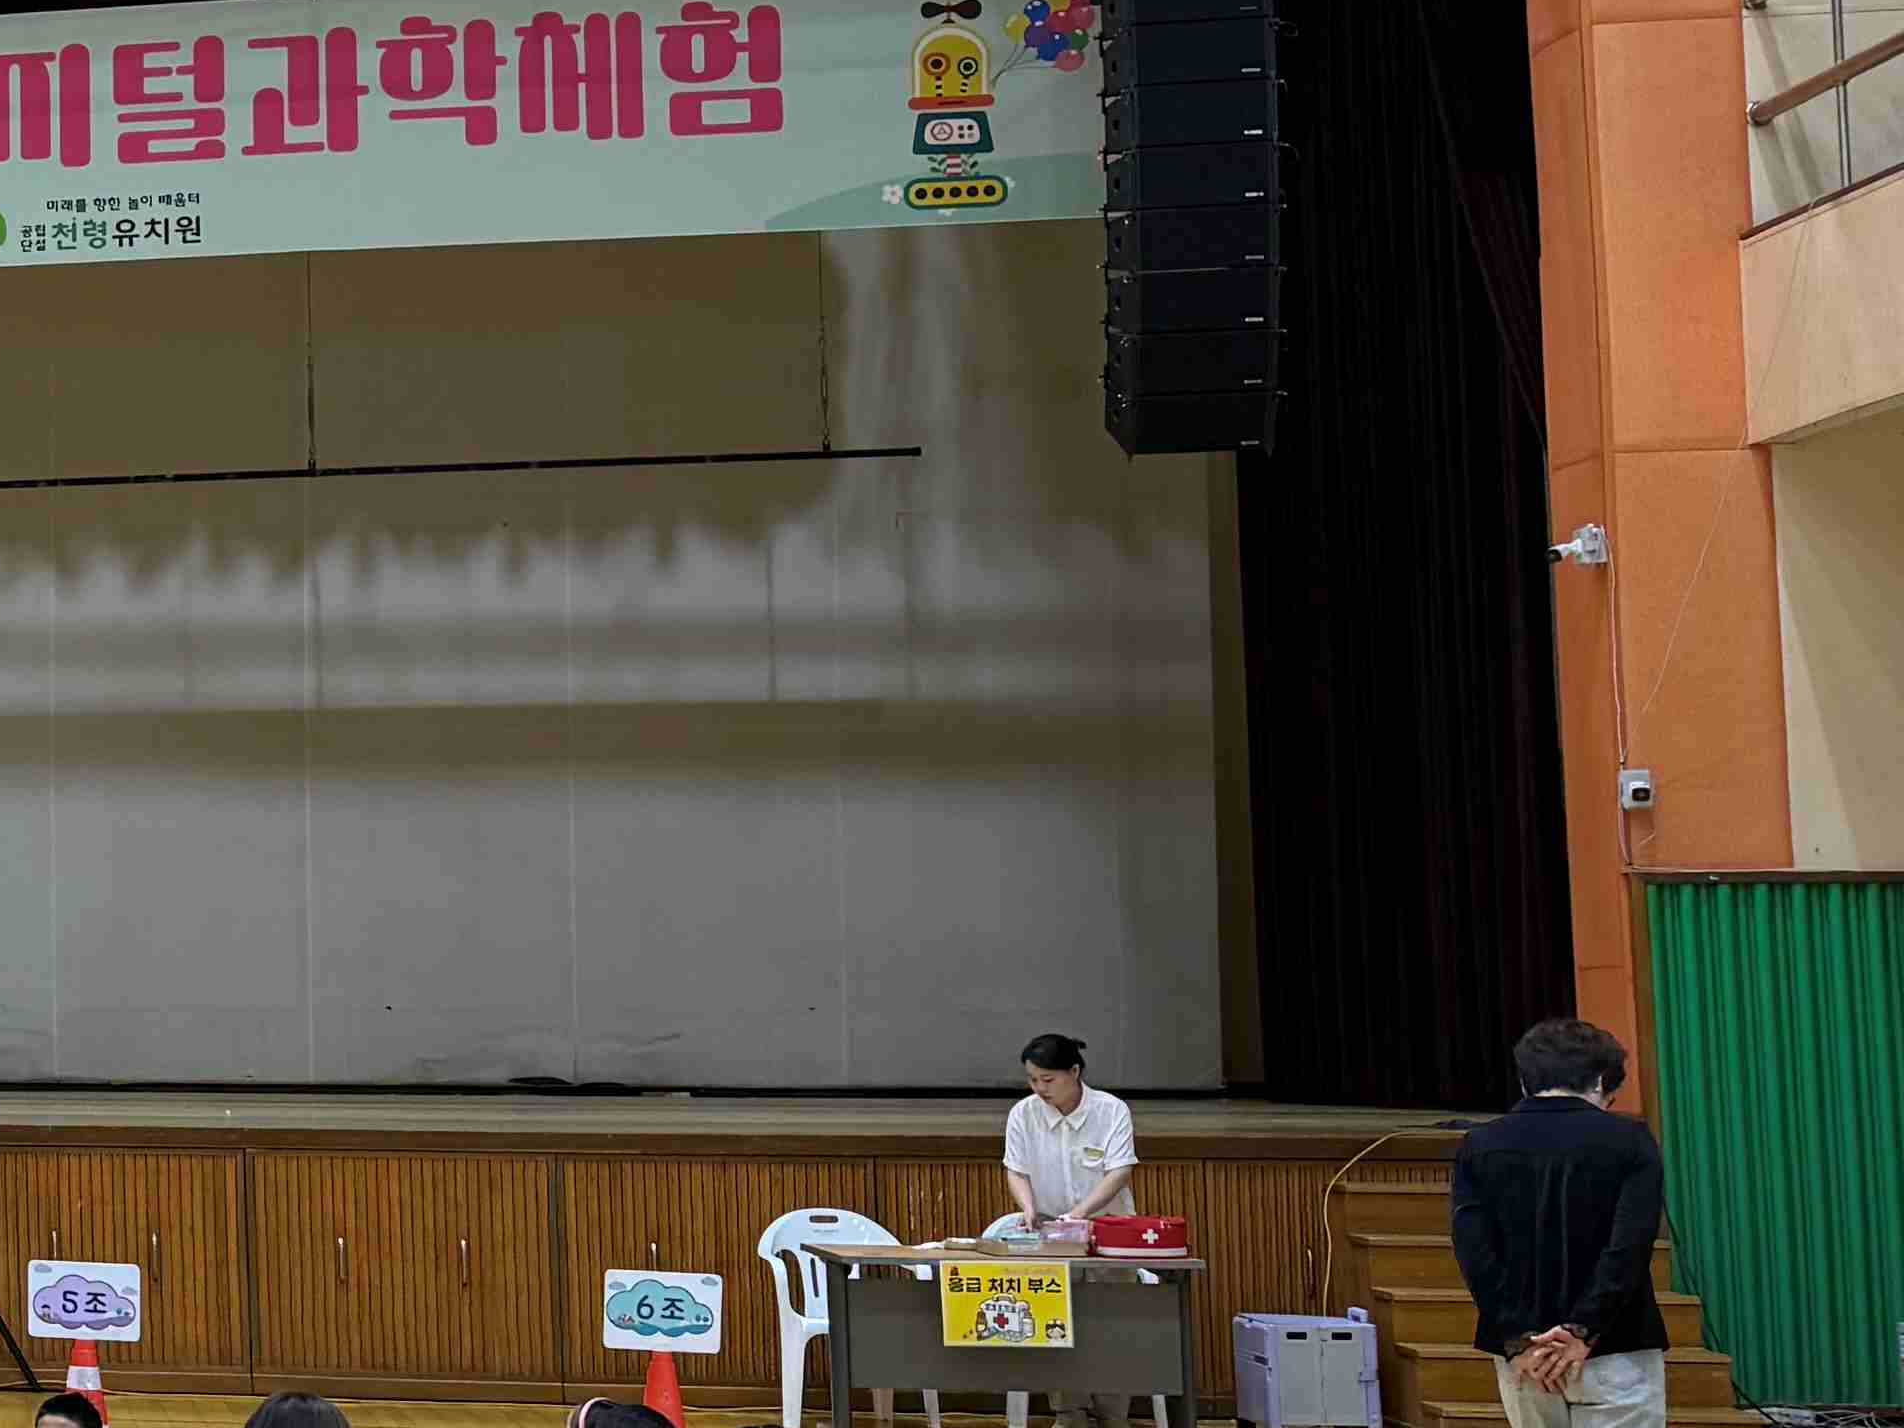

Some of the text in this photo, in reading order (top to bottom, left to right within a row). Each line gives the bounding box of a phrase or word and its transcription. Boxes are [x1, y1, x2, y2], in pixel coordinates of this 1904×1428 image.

[46, 200, 87, 213] 미래를
[93, 197, 121, 212] 향한
[50, 215, 202, 251] 천령유치원
[948, 1277, 1063, 1293] 응급 처치 부스
[60, 1290, 107, 1316] 5조
[636, 1295, 685, 1322] 6조
